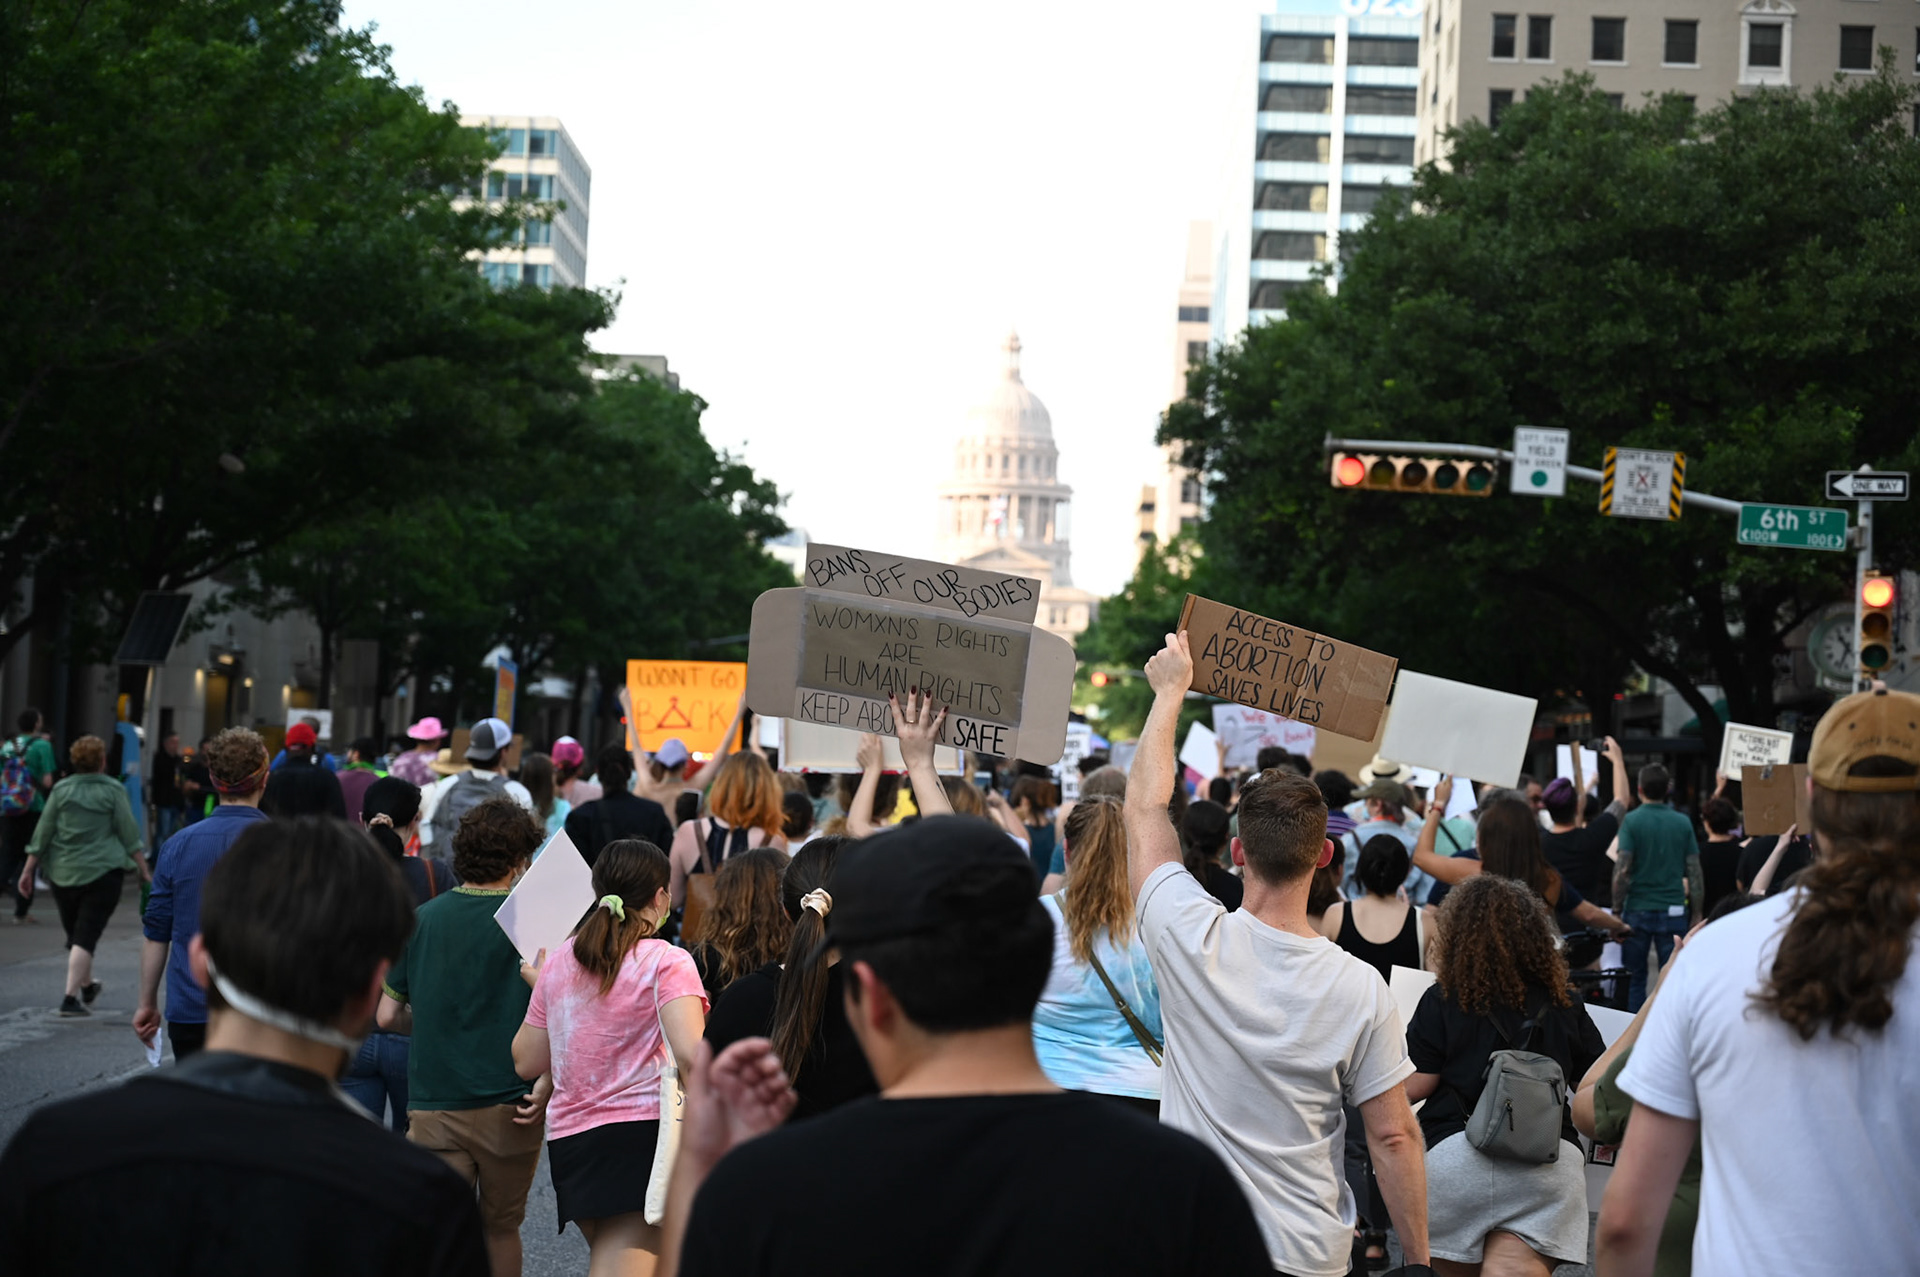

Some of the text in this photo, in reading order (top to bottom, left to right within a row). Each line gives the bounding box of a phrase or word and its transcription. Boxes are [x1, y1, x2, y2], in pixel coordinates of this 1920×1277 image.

[1528, 445, 1556, 457] YIELD
[1851, 479, 1898, 491] ONE WAY
[1750, 529, 1834, 547] 100W 100E
[1760, 508, 1827, 531] 6th ST
[808, 549, 1032, 618] BANS OFF OUR BODIES
[813, 604, 1010, 657] WOMXN'S RIGHTS
[877, 642, 924, 666] ARE
[1226, 611, 1335, 661] ACCESS TO
[711, 667, 738, 689] GO
[824, 653, 1002, 716] HUMAN RIGHTS
[1201, 633, 1327, 694] ABORTION
[1208, 669, 1324, 723] SAVES LIVES
[800, 692, 849, 725] KEEP
[952, 718, 1008, 756] SAFE
